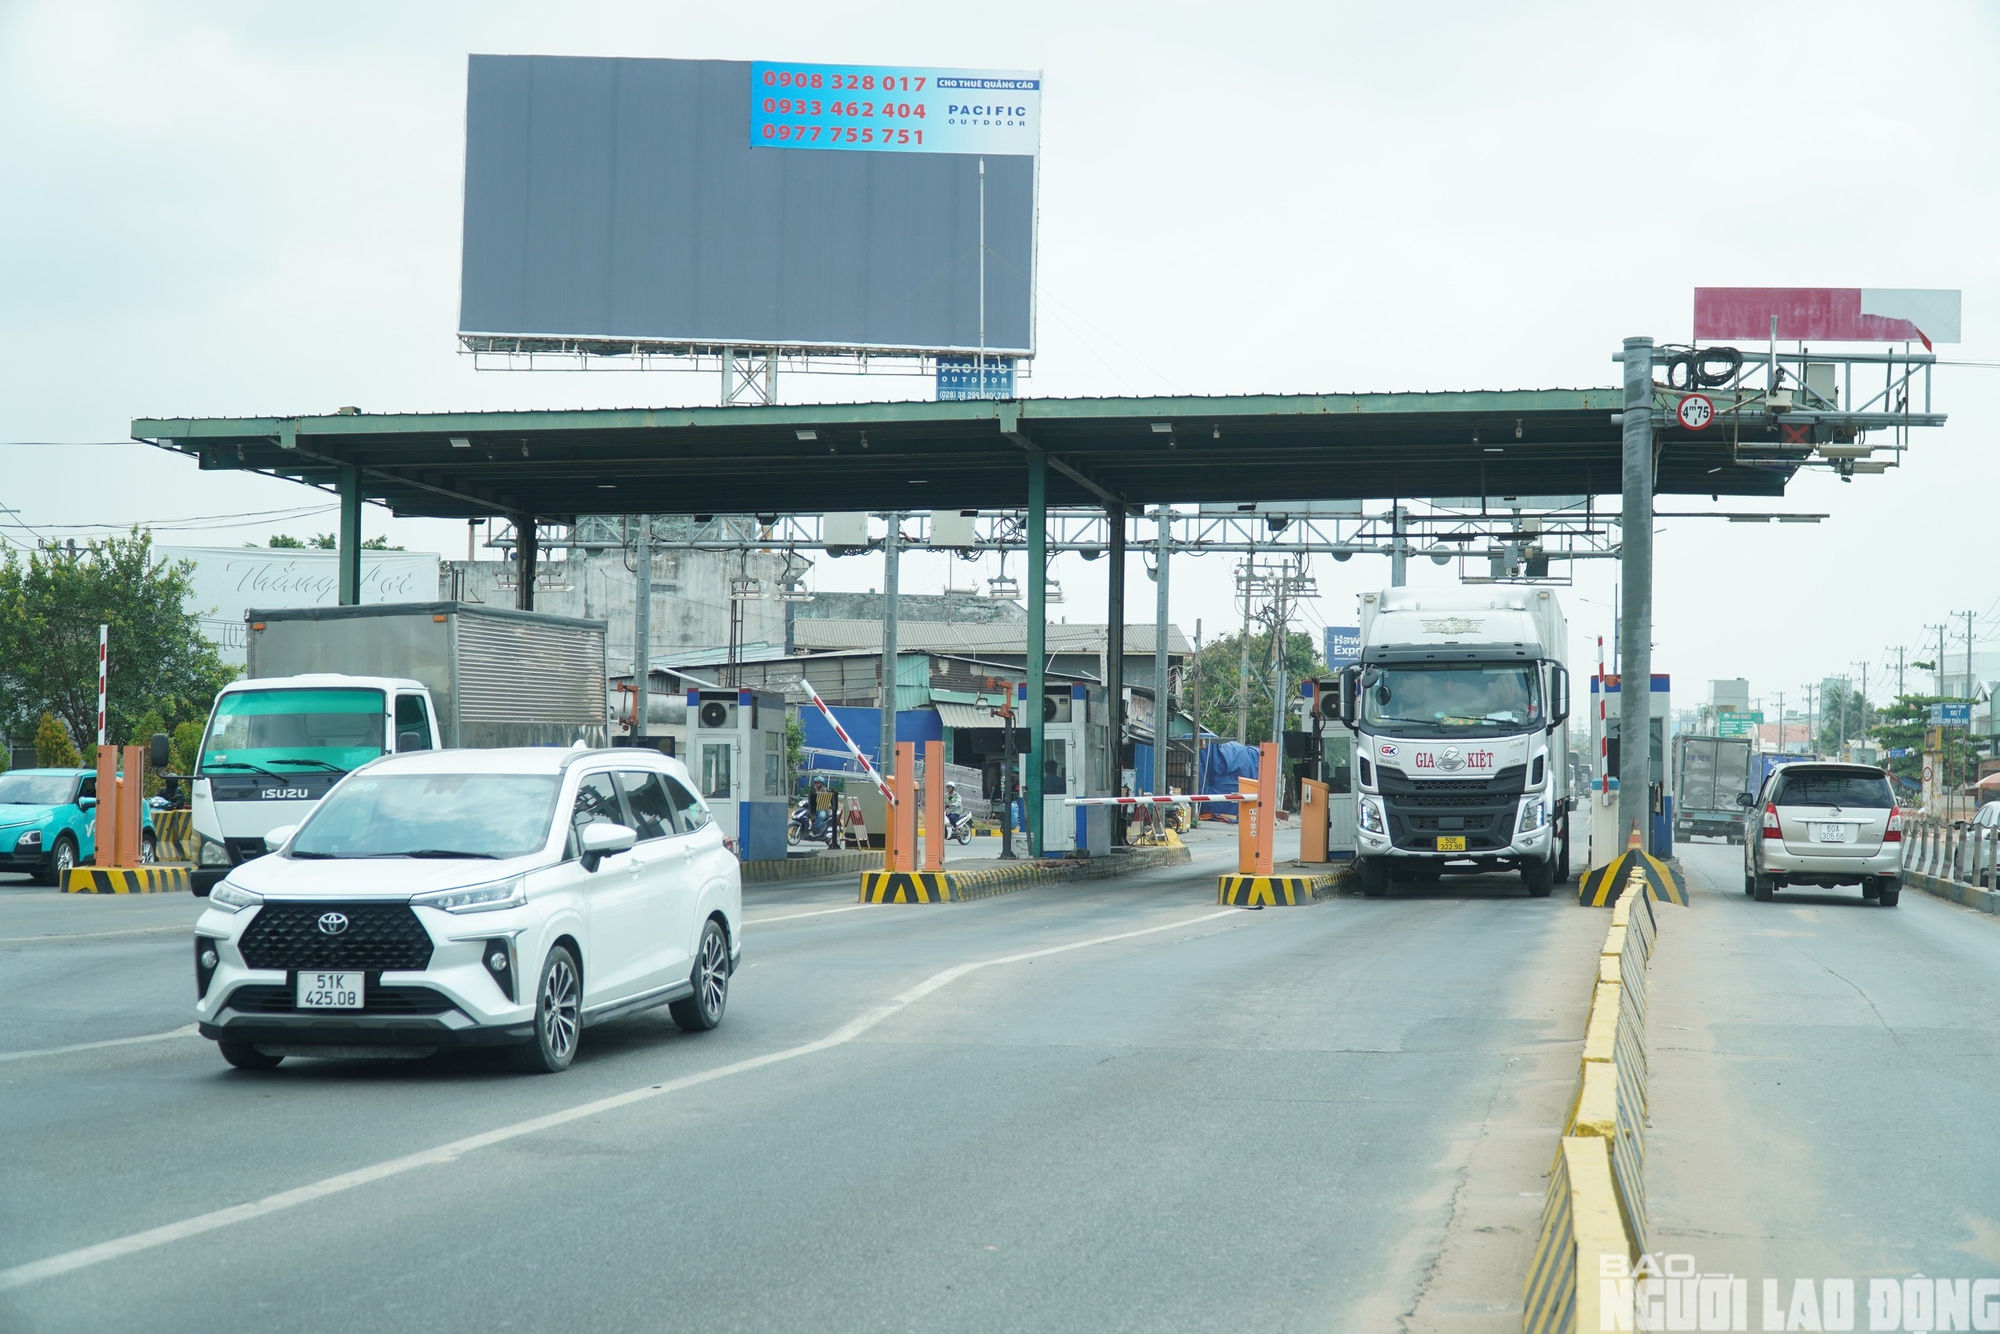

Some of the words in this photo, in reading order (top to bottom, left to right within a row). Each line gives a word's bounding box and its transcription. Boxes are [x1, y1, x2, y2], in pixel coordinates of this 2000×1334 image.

[763, 70, 823, 89] 0908
[830, 74, 875, 90] 328
[882, 75, 927, 92] 017
[959, 79, 982, 88] THUÊ
[1016, 80, 1034, 89] CÁO
[763, 98, 823, 115] 0933
[830, 101, 874, 117] 462
[882, 103, 926, 119] 404
[948, 105, 1026, 117] PACIFIC
[948, 118, 1025, 127] OUTDOOR
[762, 123, 822, 141] 0977
[830, 127, 874, 143] 755
[882, 128, 923, 144] 751
[1381, 746, 1396, 755] GK
[1415, 752, 1435, 768] GIA
[1467, 749, 1494, 771] KIỆT
[262, 788, 308, 799] ISUZU
[1826, 824, 1840, 832] 60A
[317, 974, 344, 989] 51K
[305, 991, 356, 1006] 425.08
